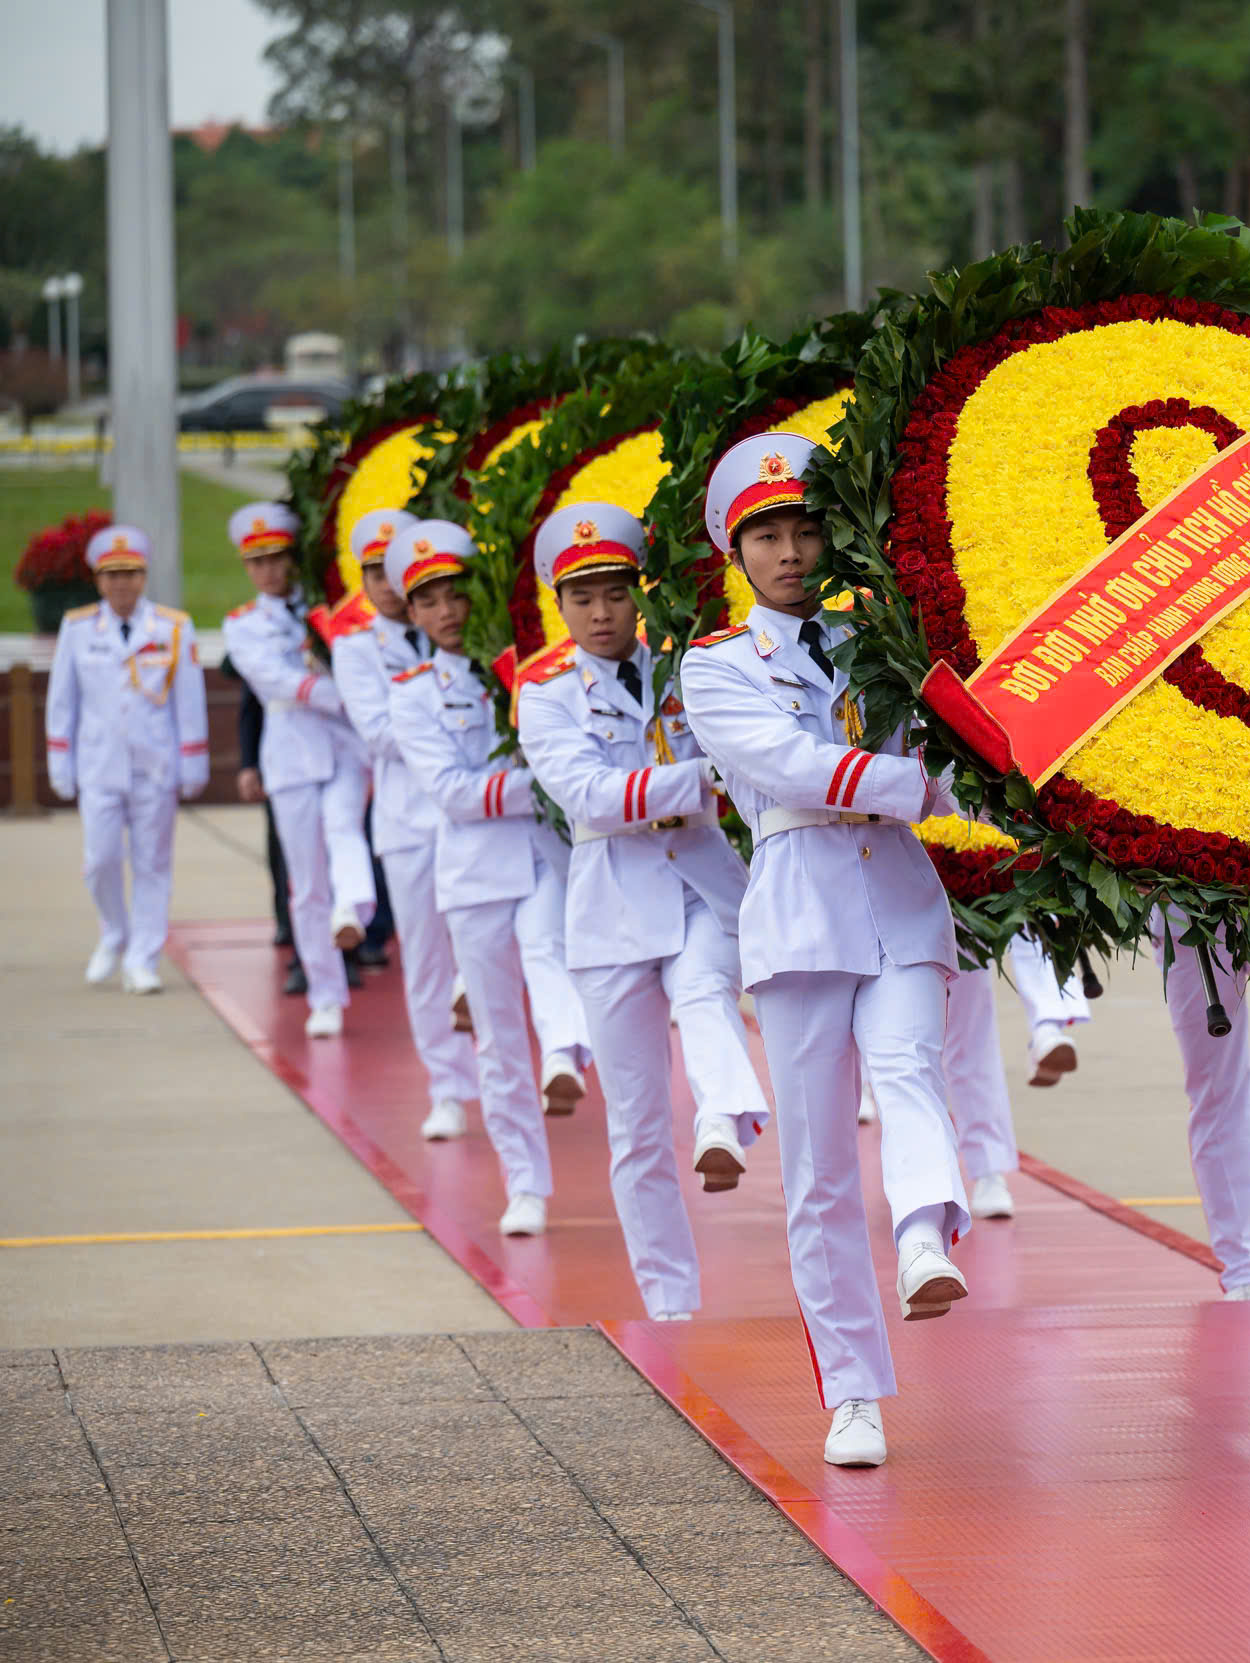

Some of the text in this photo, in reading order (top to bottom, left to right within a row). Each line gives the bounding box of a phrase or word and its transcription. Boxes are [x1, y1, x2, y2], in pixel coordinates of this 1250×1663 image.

[1000, 659, 1059, 703] ĐỜI
[1031, 629, 1091, 673] ĐỜI
[1063, 591, 1128, 646] NHỚ
[1104, 571, 1158, 610] ƠN
[1132, 533, 1192, 586] CHỦ
[1167, 506, 1234, 555] TỊCH
[1094, 655, 1134, 688] BAN
[1118, 630, 1160, 666] CHẤP
[1146, 605, 1192, 640] HÀNH
[1176, 576, 1227, 614] TRUNG
